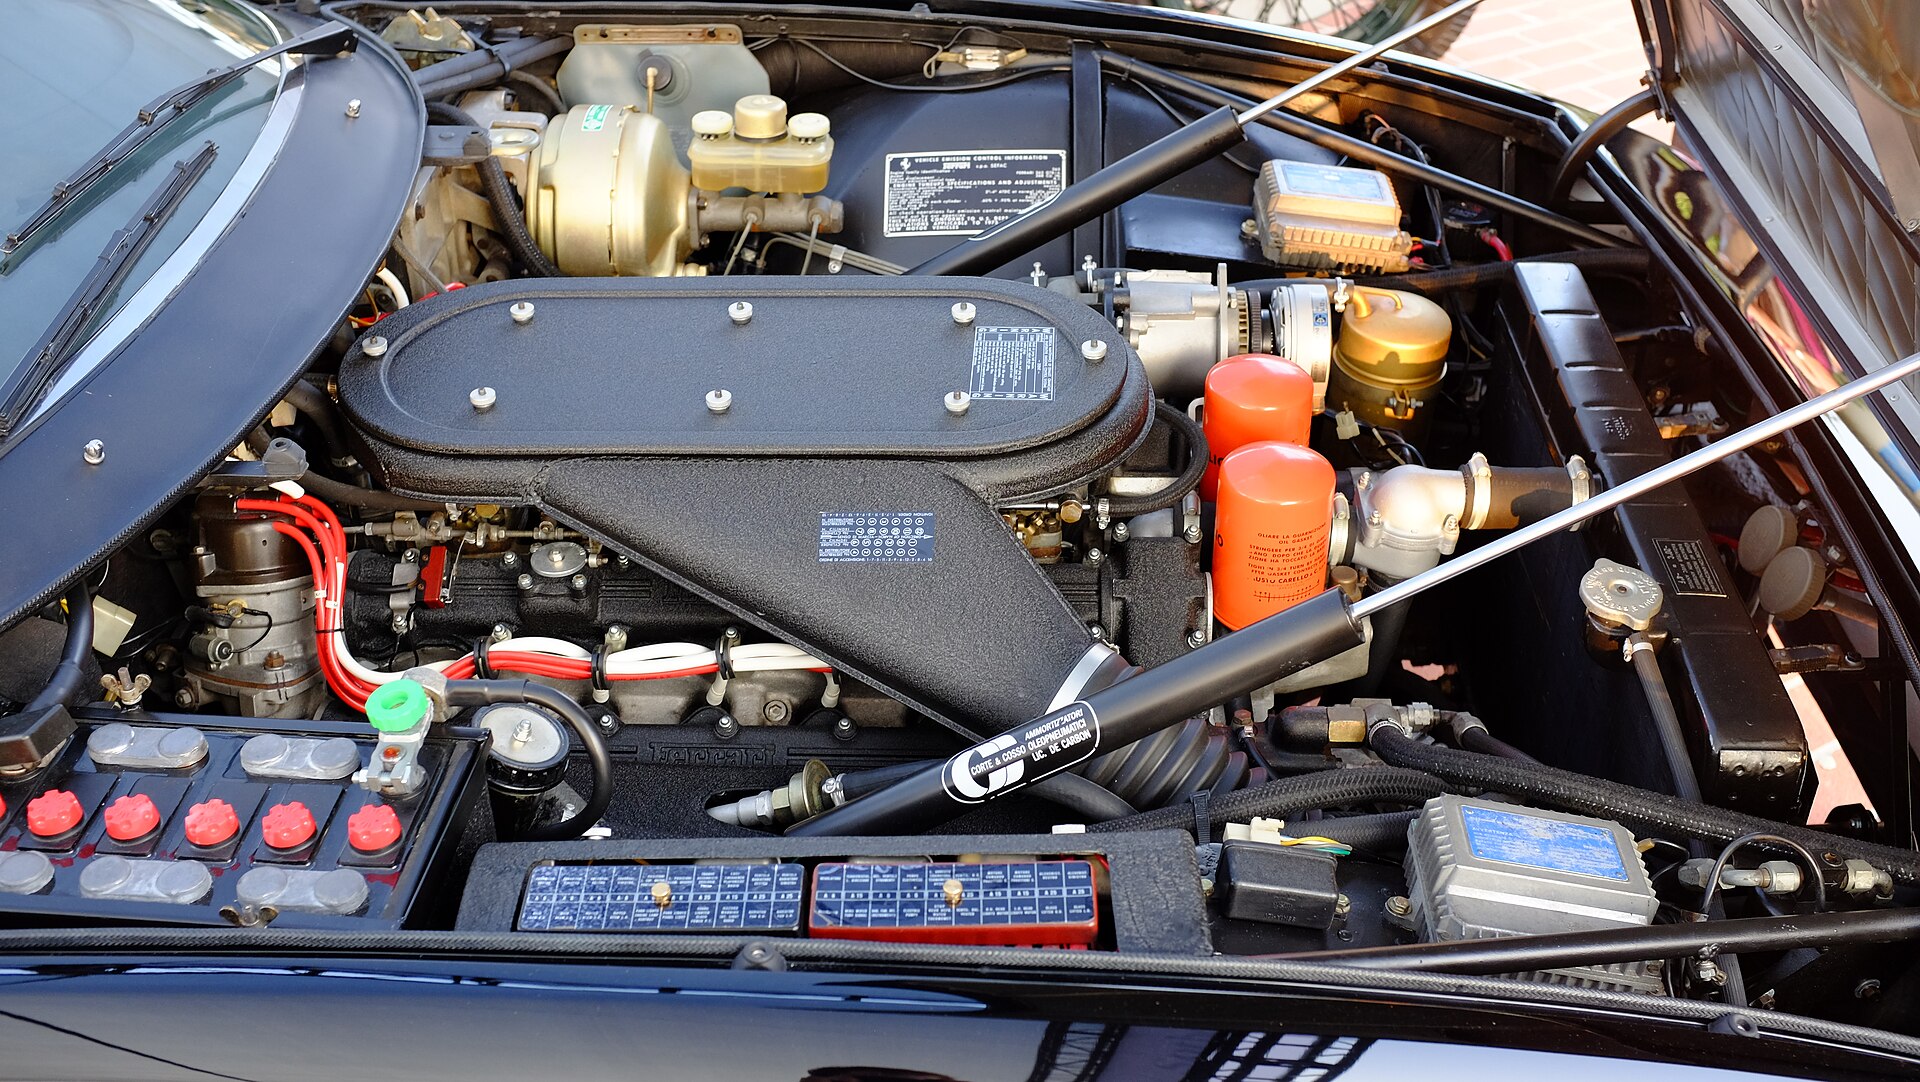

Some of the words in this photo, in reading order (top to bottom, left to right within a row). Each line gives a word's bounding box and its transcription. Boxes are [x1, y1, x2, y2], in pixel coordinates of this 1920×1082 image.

[1249, 544, 1282, 552] STRINGERE
[1282, 555, 1308, 563] TOCCATO
[1278, 573, 1309, 584] CARELLO
[1028, 718, 1087, 750] OLEOPNEUMATICI
[1032, 751, 1048, 762] LIC.
[1049, 744, 1060, 753] DE
[1060, 729, 1092, 749] CARBON
[649, 742, 776, 765] Ferrari
[970, 759, 994, 776] CORTE
[995, 756, 1001, 765] &
[1002, 744, 1027, 762] COSSO
